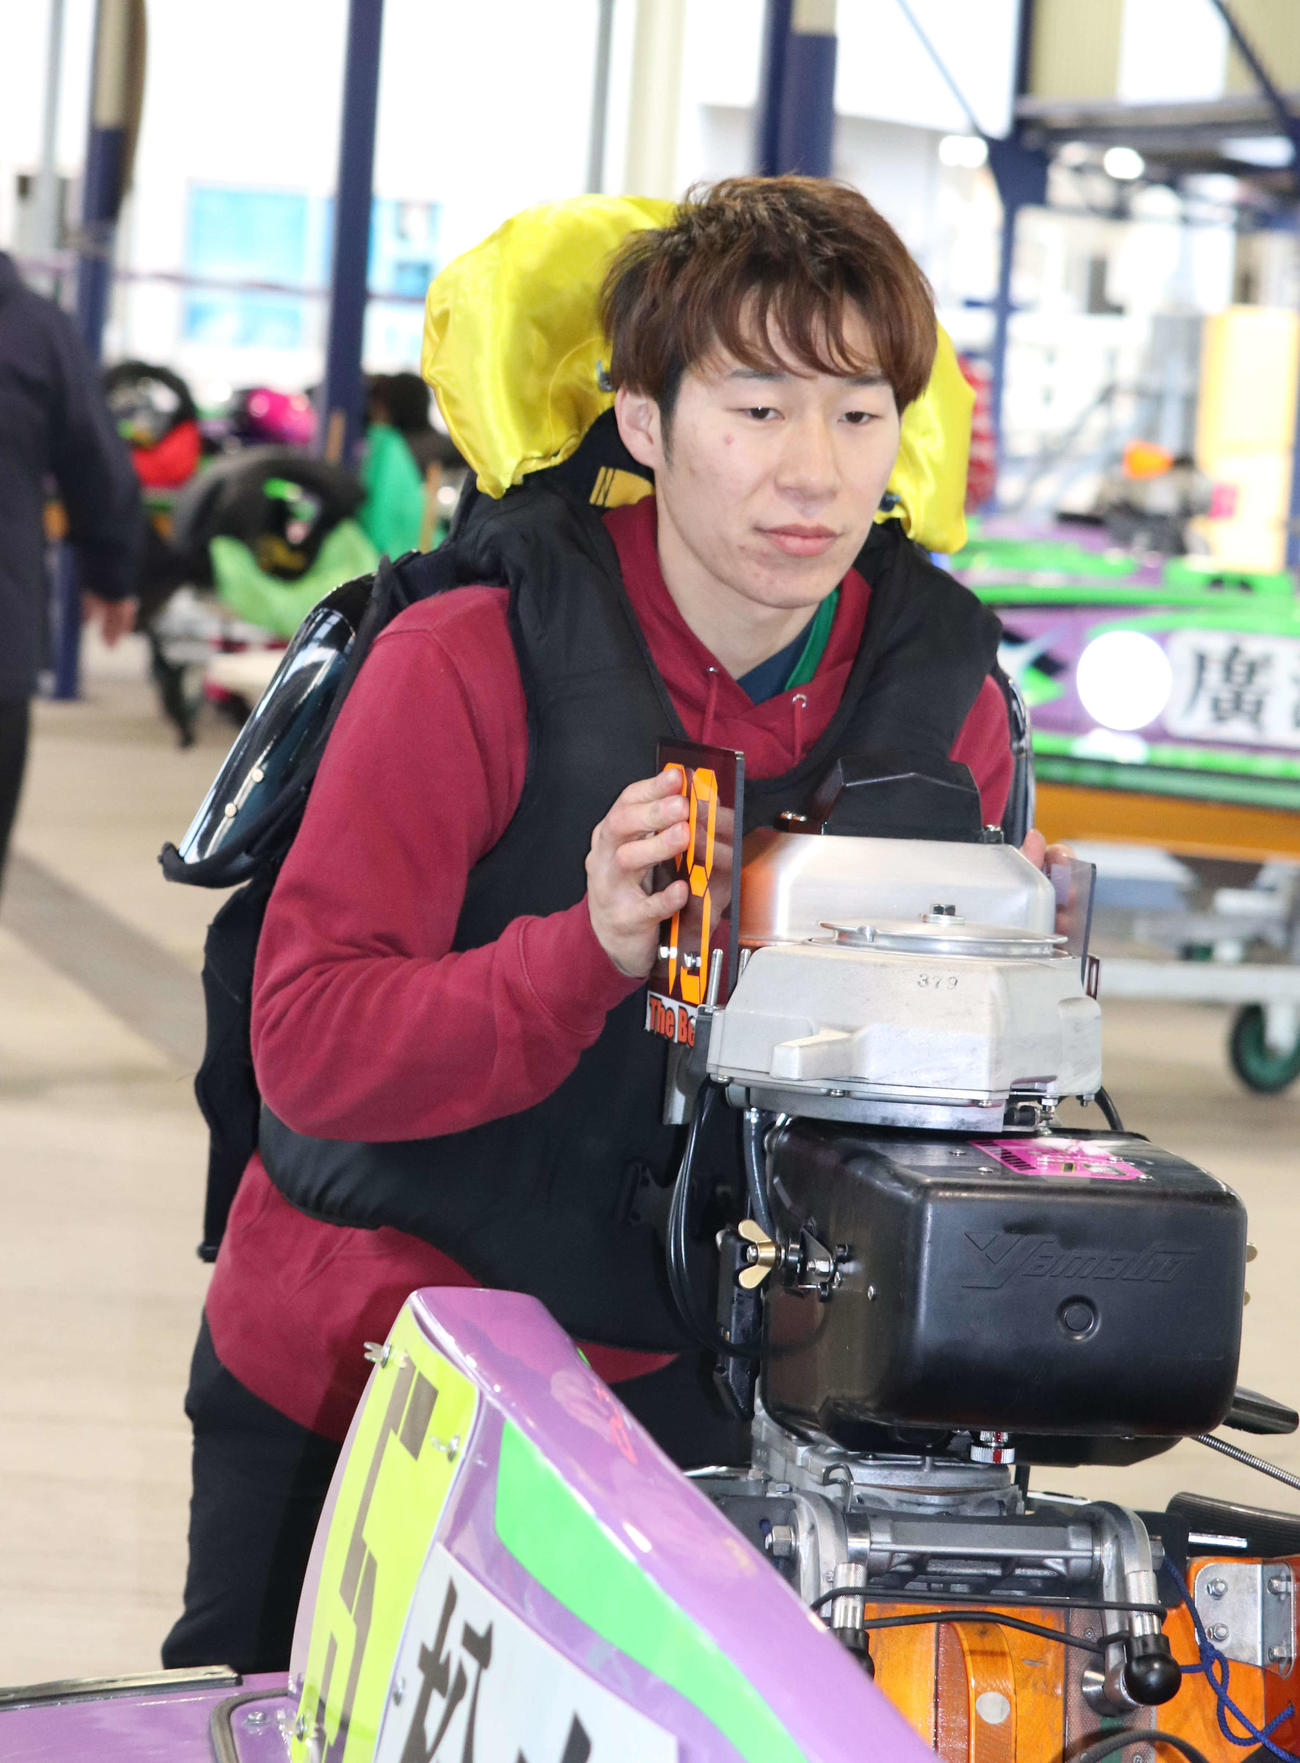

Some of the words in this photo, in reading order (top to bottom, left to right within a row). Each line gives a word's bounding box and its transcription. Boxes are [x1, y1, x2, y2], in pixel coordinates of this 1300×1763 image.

[1178, 644, 1300, 732] 廣
[917, 972, 958, 990] 379
[649, 995, 676, 1040] The
